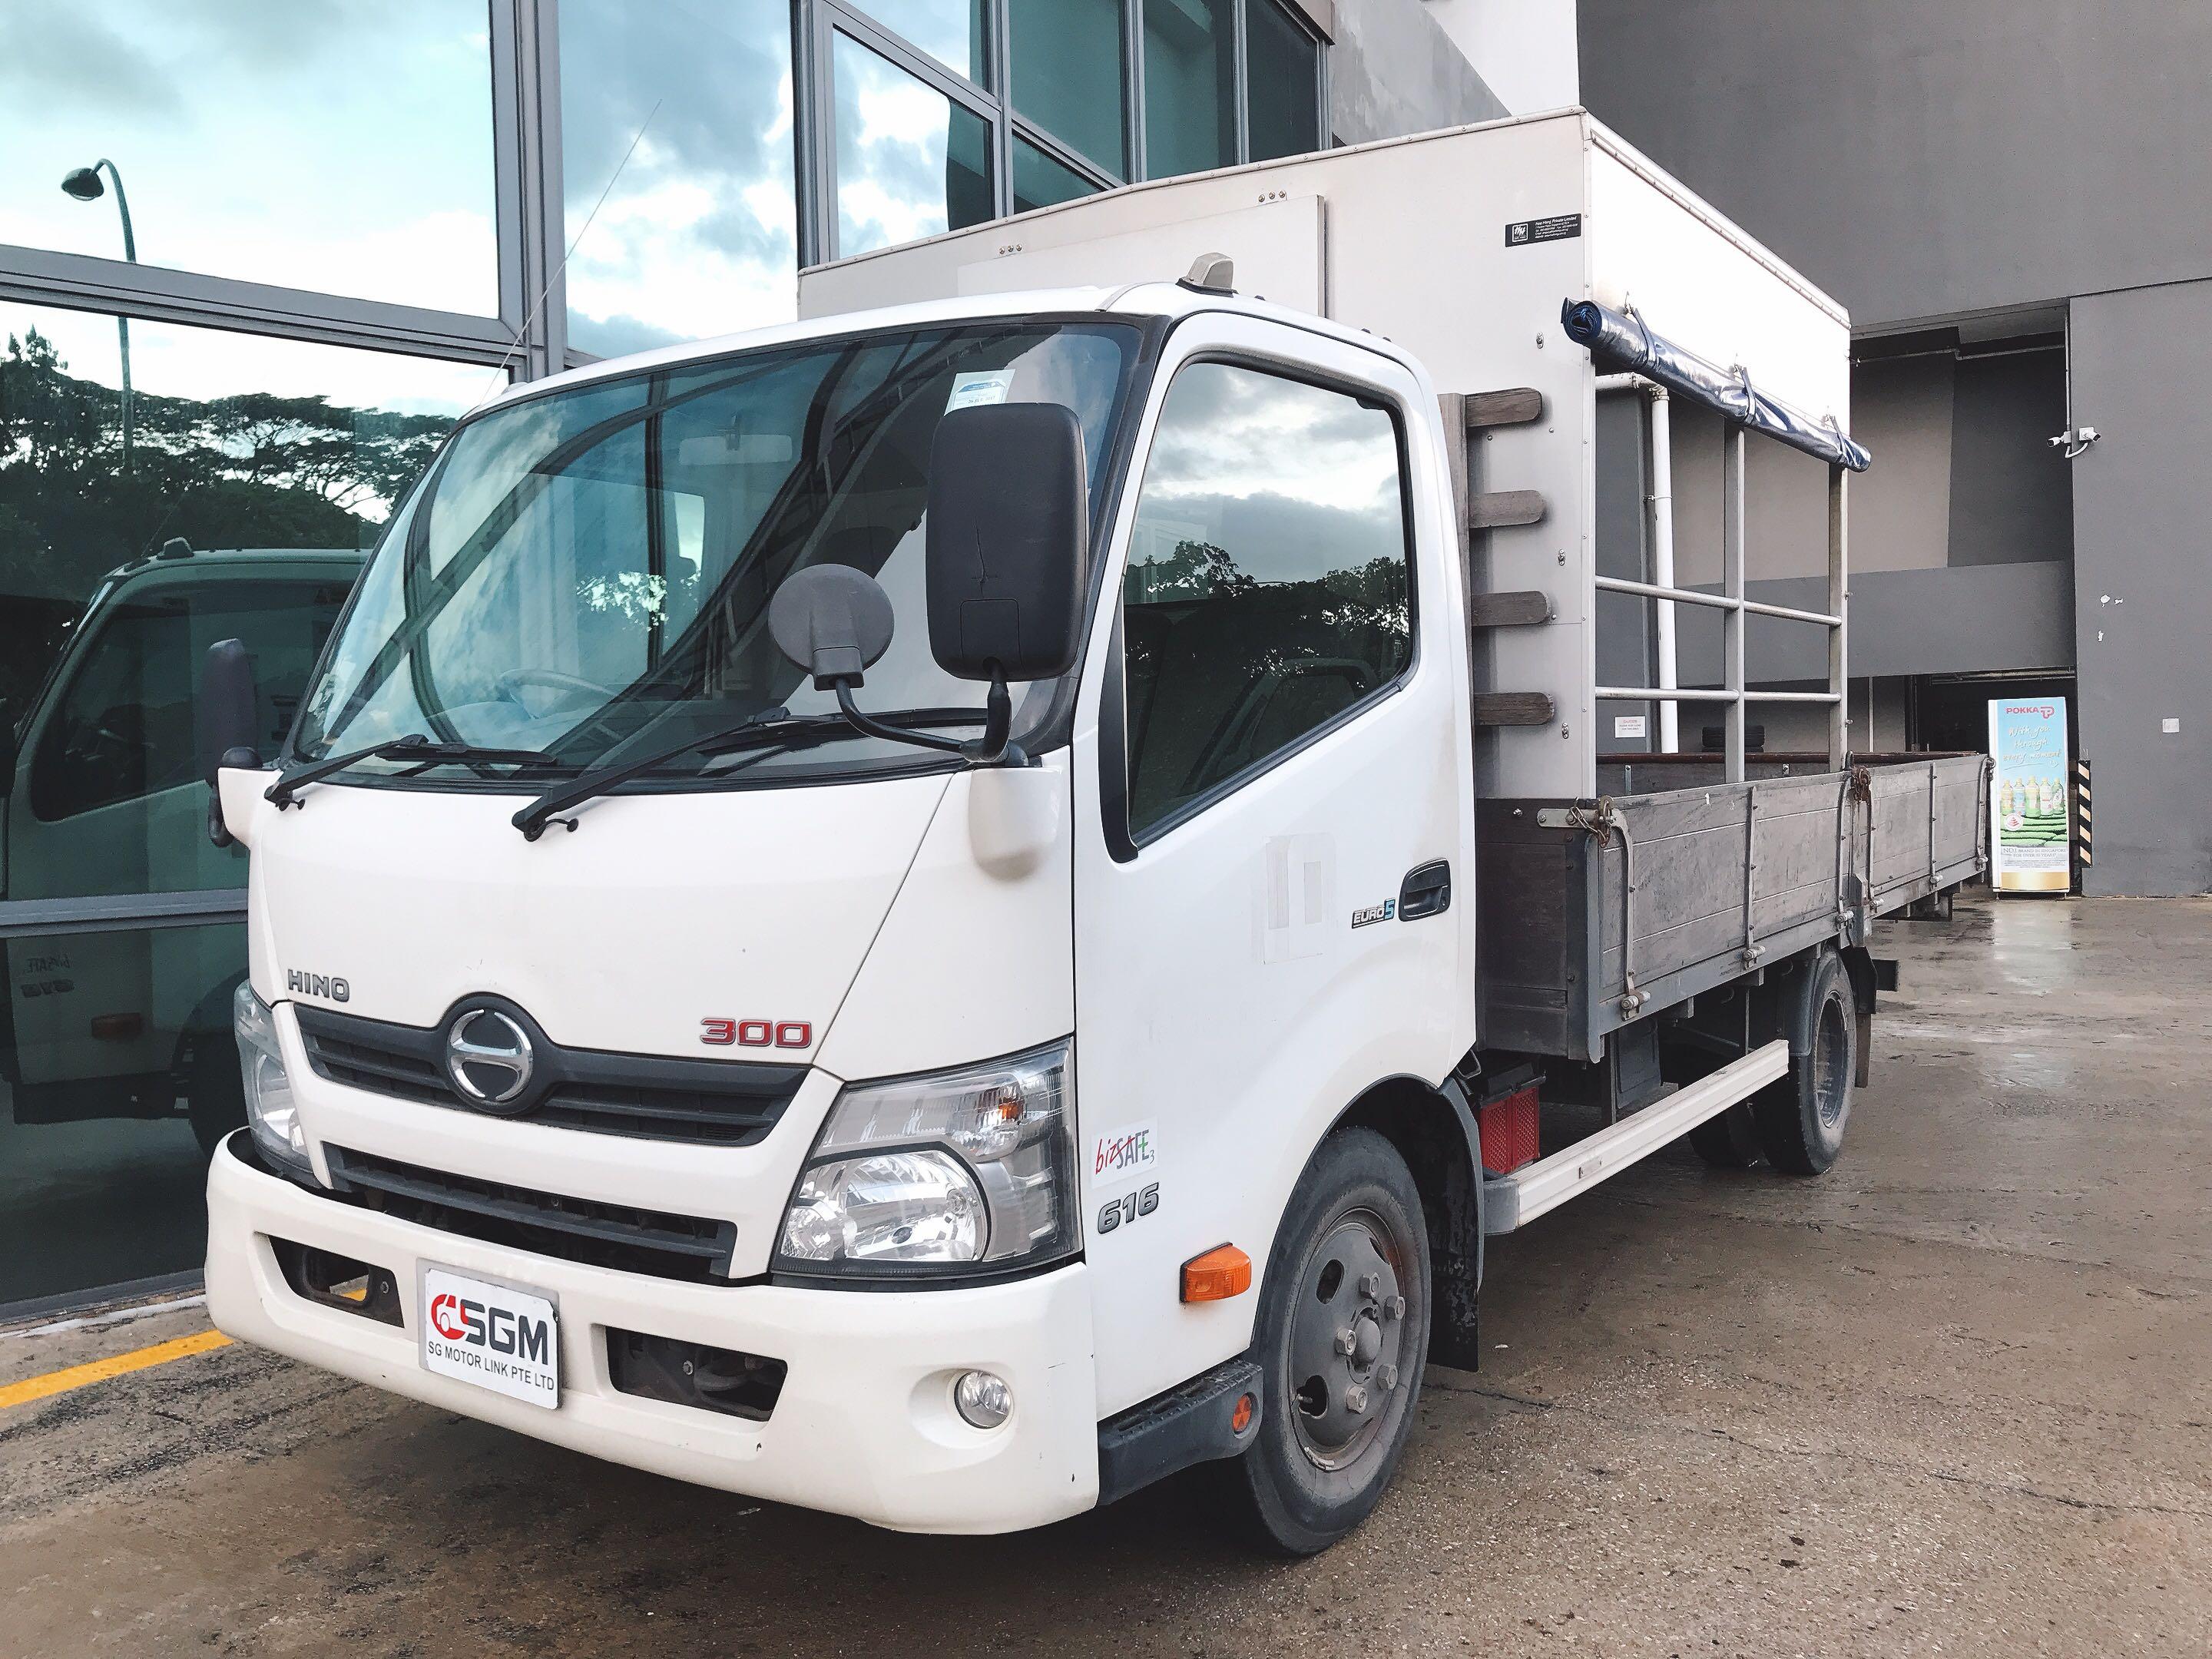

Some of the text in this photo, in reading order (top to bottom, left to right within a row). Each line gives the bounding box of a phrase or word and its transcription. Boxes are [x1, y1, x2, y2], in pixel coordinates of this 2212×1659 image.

[288, 969, 349, 1002] HINO
[700, 1017, 813, 1048] 300
[1098, 1182, 1159, 1234] 616
[428, 1341, 555, 1391] SG MOTOR LINK PTE LTD
